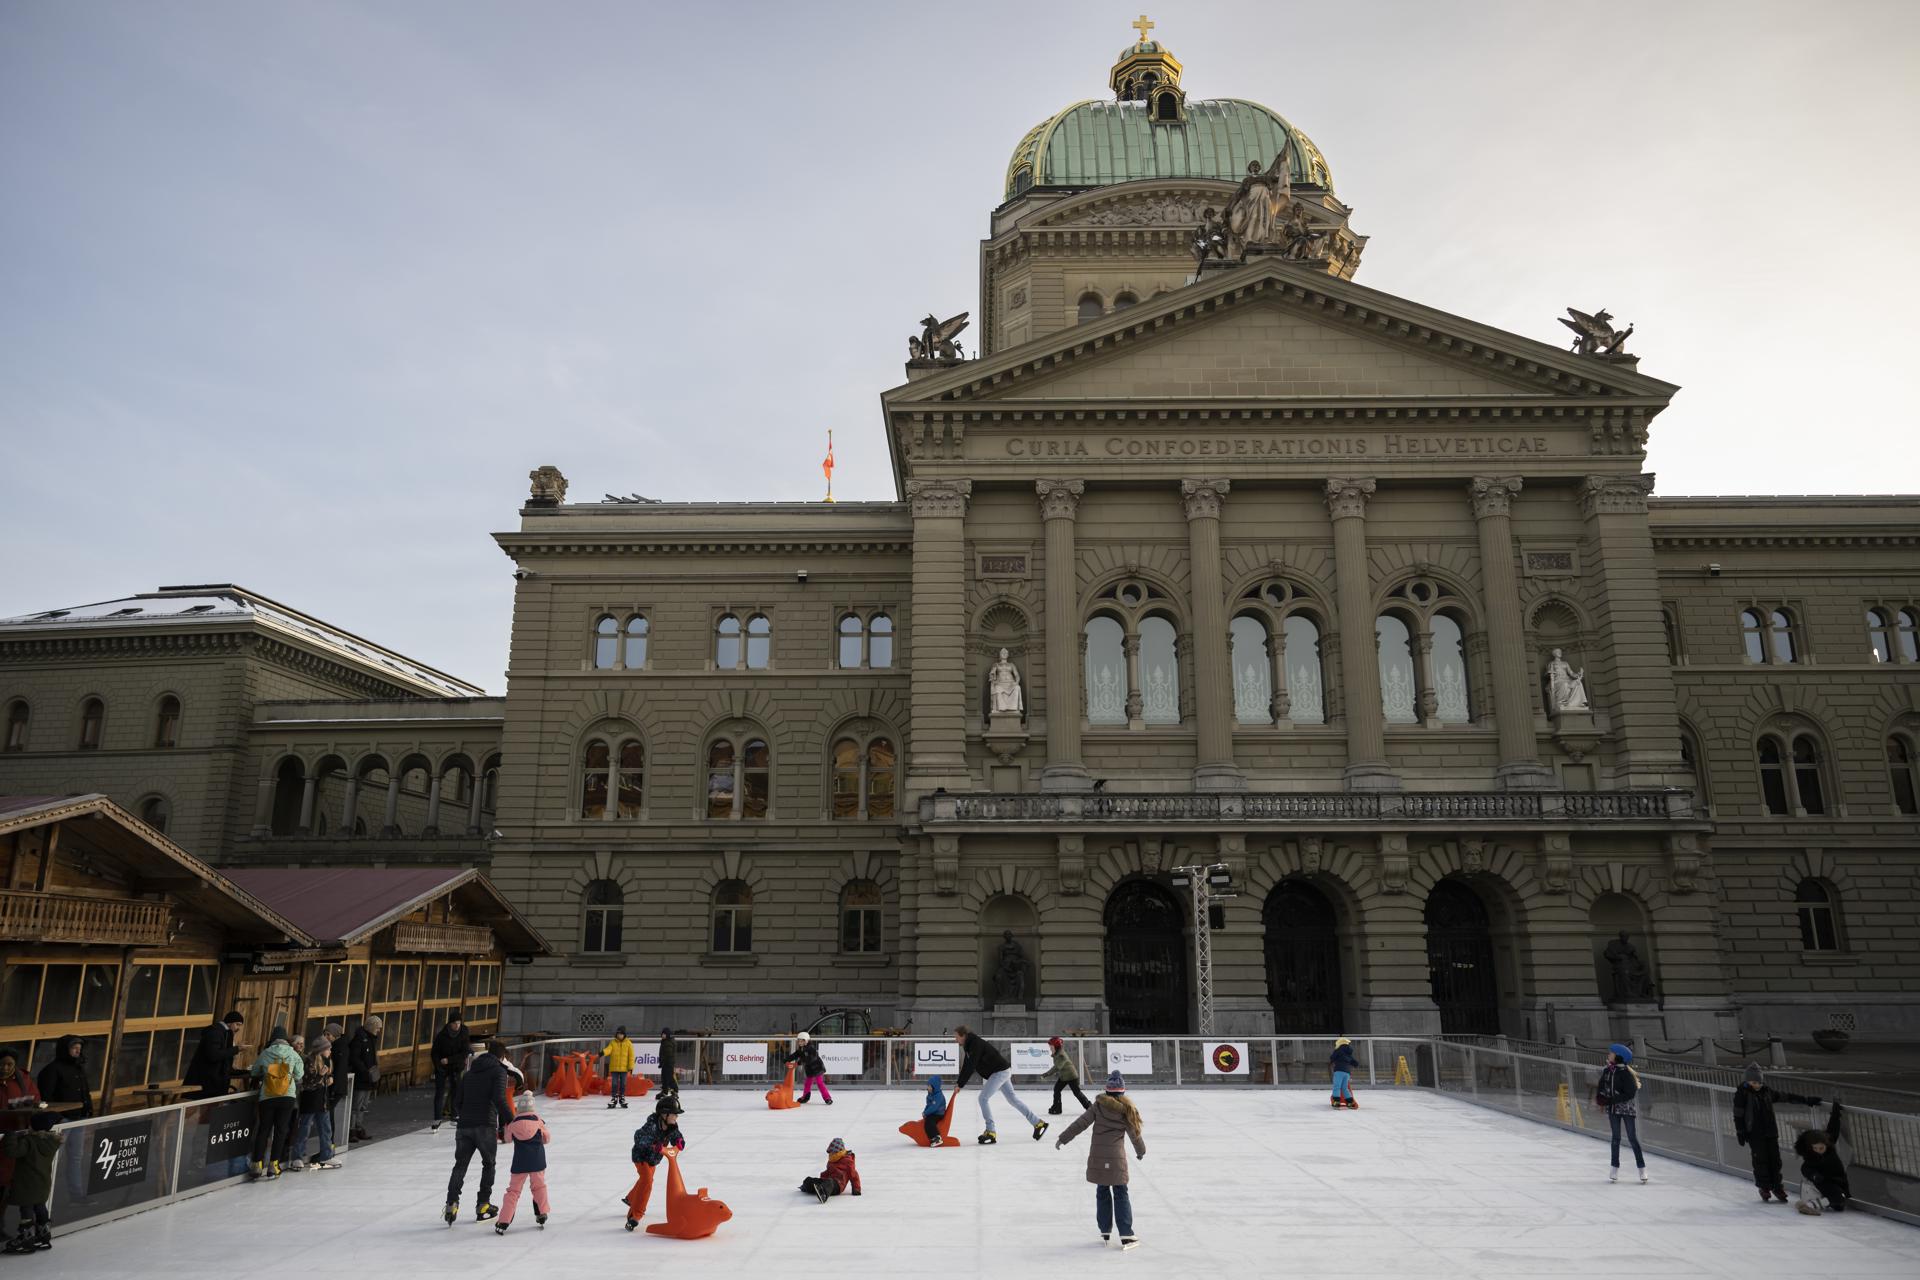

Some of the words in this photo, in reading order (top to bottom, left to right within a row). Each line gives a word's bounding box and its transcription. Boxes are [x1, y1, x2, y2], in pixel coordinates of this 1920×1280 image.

[1105, 437, 1368, 456] CONFOEDERATIONIS
[1383, 434, 1549, 455] HELVETICAE
[739, 1055, 765, 1063] Behring
[918, 1050, 956, 1062] USL
[223, 1121, 240, 1129] SPORT
[119, 1135, 147, 1147] TWENTY
[210, 1127, 250, 1144] GASTRO
[118, 1147, 137, 1158] FOUR
[116, 1157, 138, 1169] SEVEN
